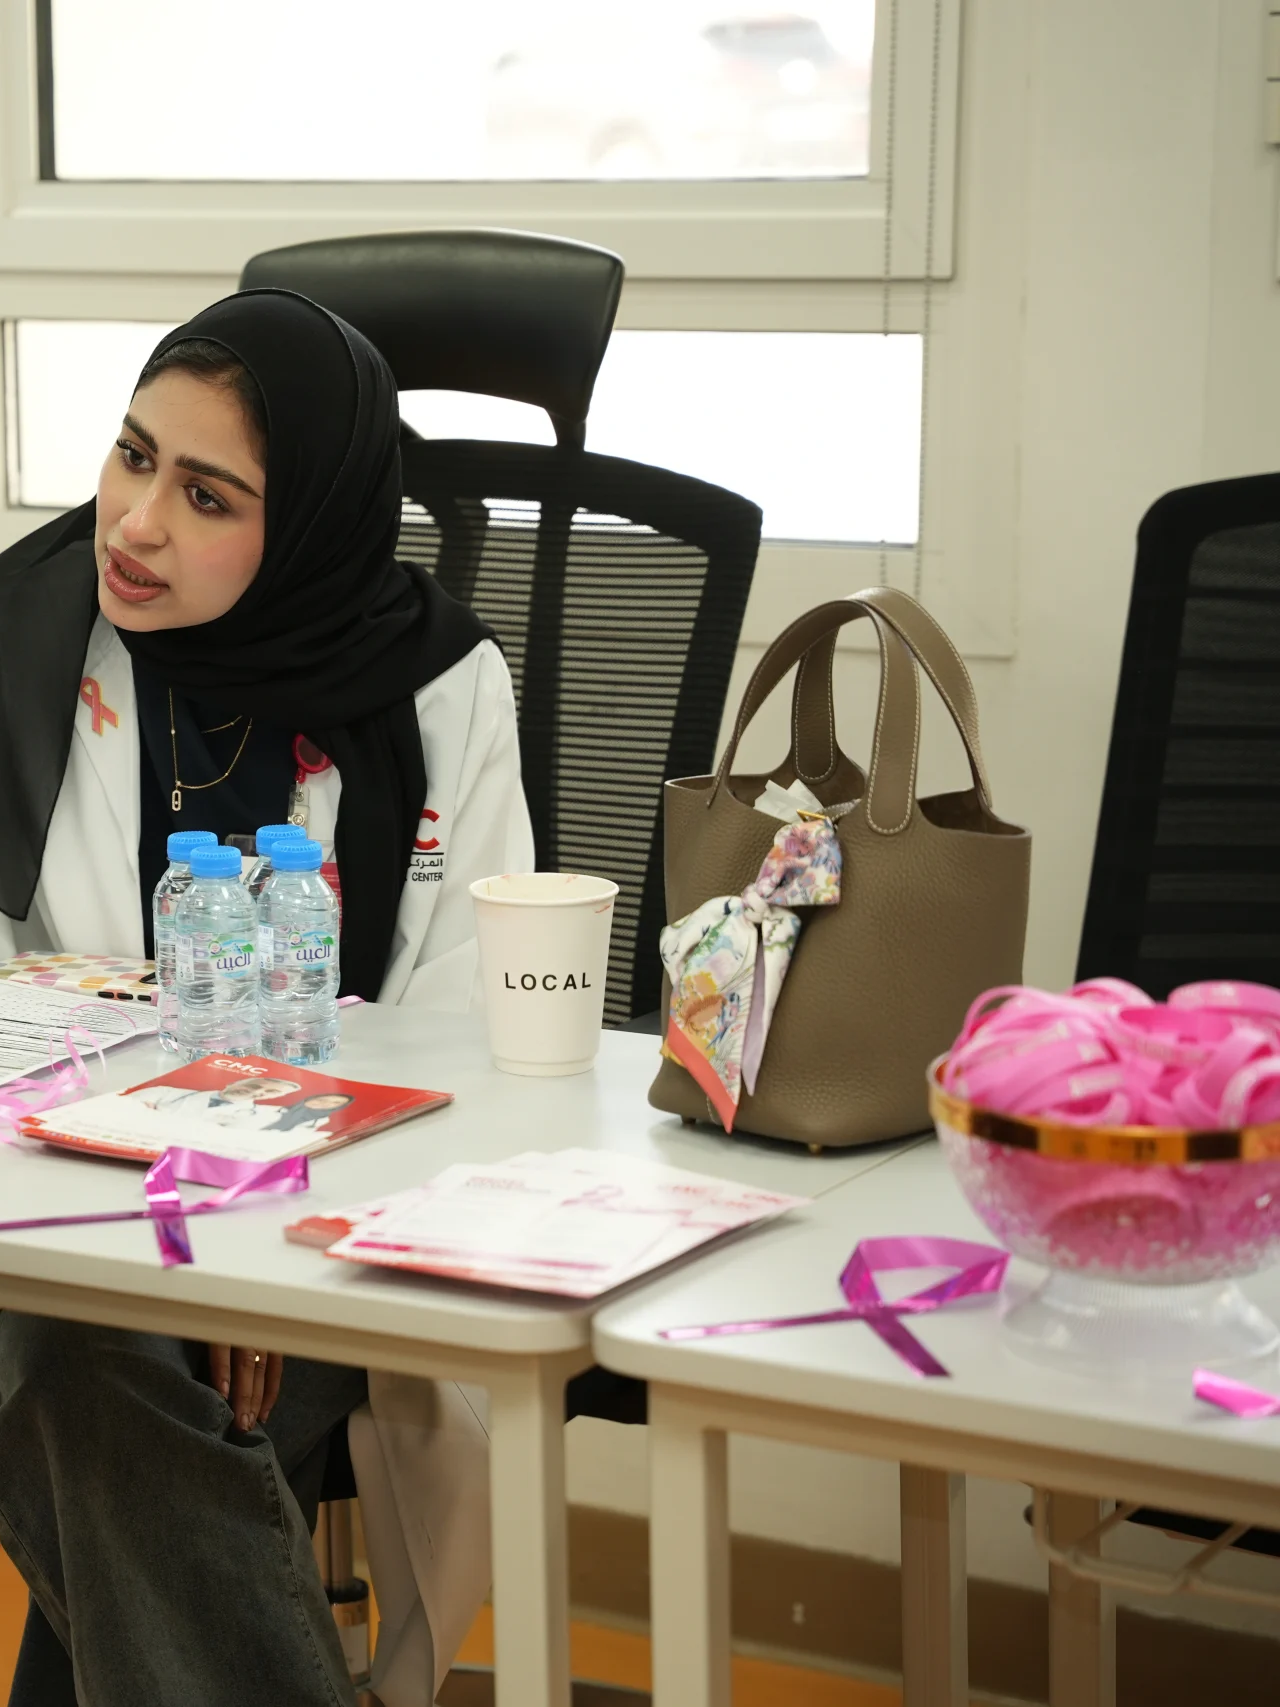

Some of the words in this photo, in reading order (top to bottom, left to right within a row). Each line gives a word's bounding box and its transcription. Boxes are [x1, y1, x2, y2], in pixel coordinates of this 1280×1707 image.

[411, 872, 444, 882] CENTER
[216, 952, 251, 971] العين
[296, 944, 331, 963] العين
[505, 972, 591, 991] LOCAL
[213, 1059, 269, 1075] CMC
